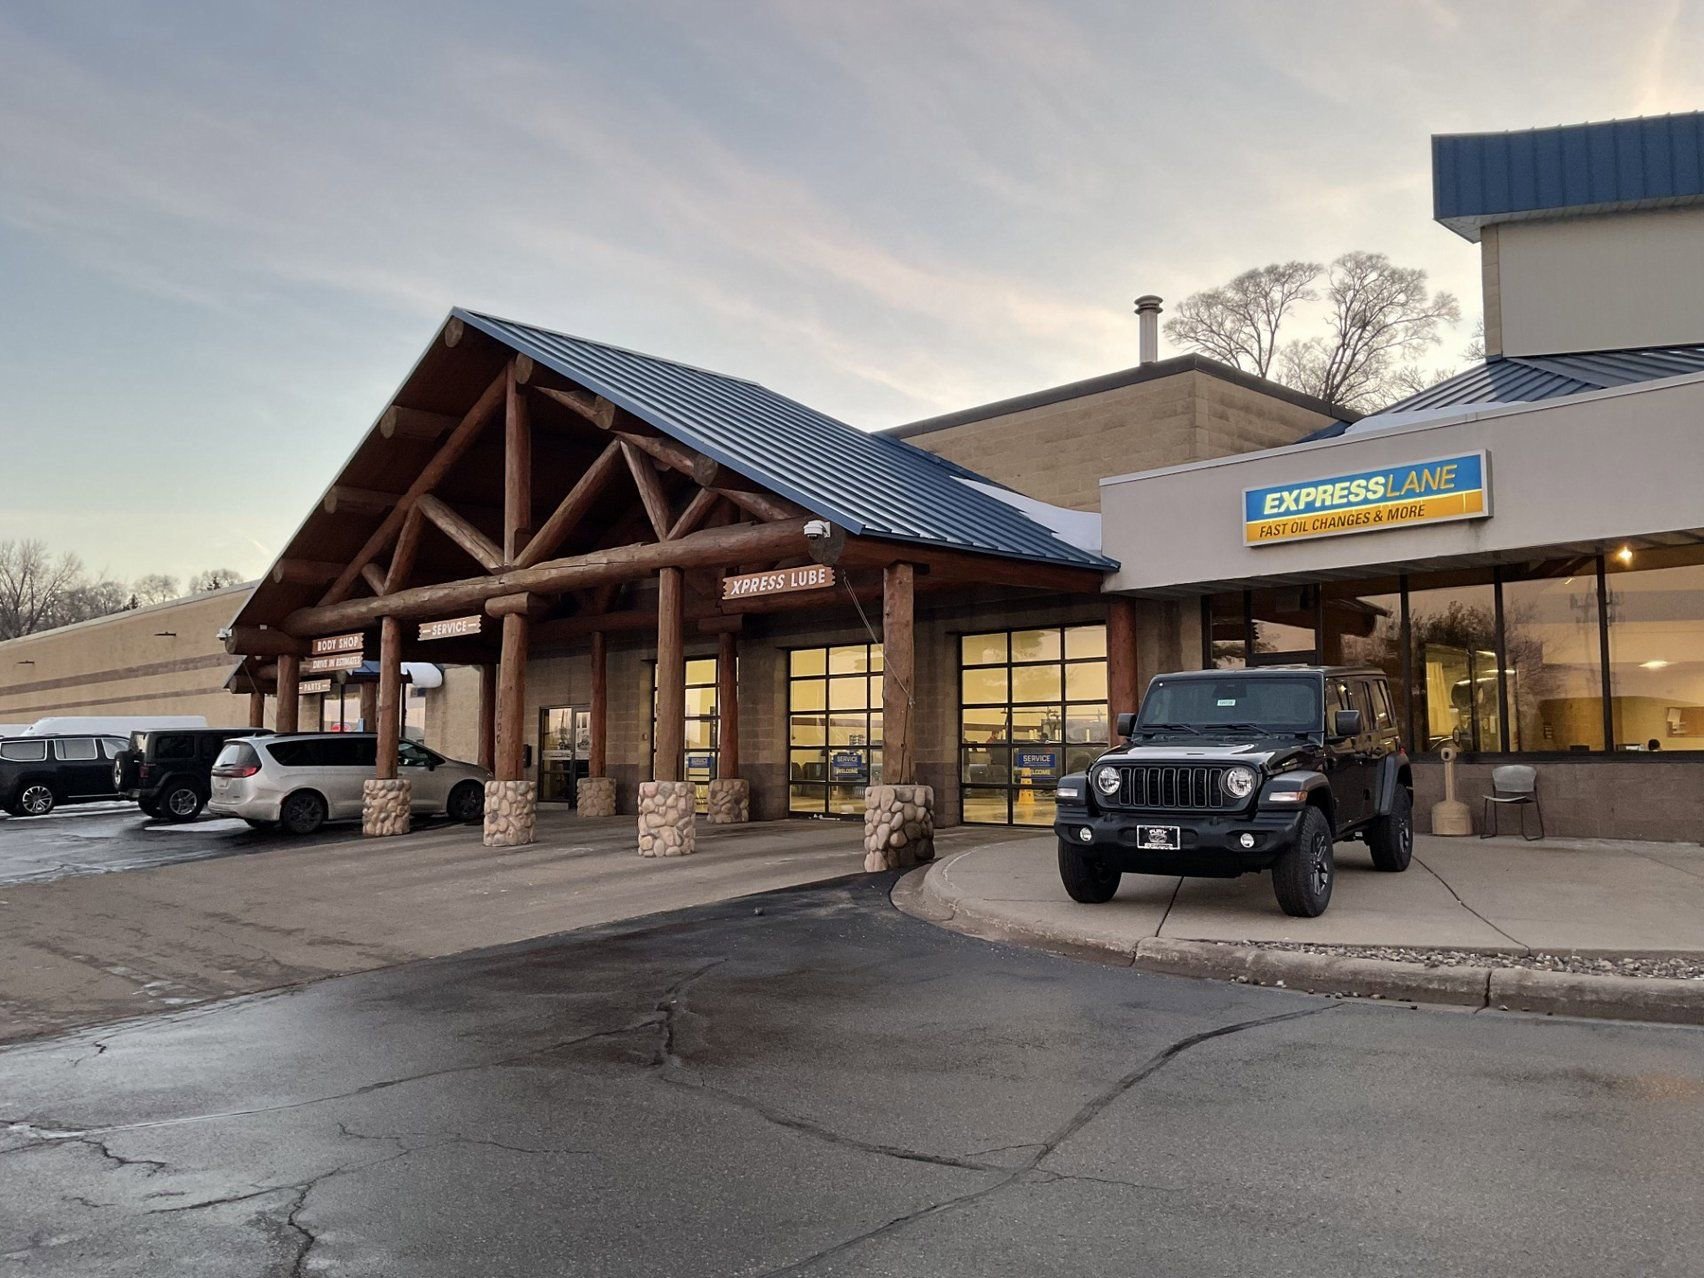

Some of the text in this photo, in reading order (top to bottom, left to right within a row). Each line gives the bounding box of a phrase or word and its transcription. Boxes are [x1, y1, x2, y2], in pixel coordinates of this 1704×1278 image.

[1259, 504, 1425, 538] FAST OIL CHANGES & MORE
[730, 568, 826, 595] XPRESS LUBE
[432, 621, 467, 635] SERVICE
[317, 636, 359, 651] BODY SHOP
